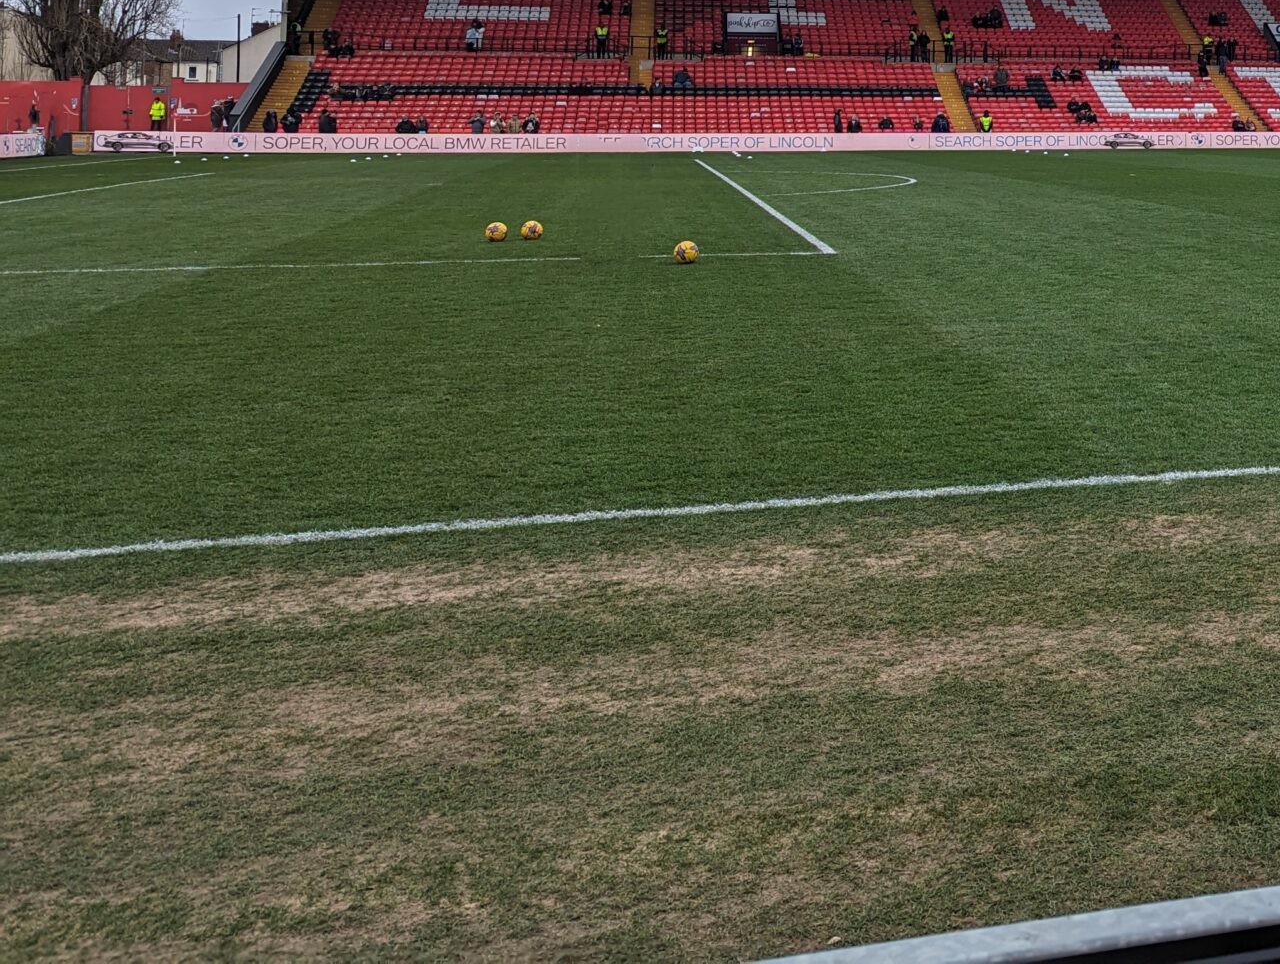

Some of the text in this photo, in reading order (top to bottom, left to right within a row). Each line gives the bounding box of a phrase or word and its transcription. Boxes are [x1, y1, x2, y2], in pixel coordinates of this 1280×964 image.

[263, 137, 567, 152] SOPER, YOUR LOCAL BMW RETAILER
[687, 136, 739, 149] SOPER
[744, 136, 765, 149] OF
[768, 136, 834, 148] LINCOLN
[935, 135, 1107, 148] SEARCH SOPER OF LINCO
[1215, 135, 1262, 147] SOPER,
